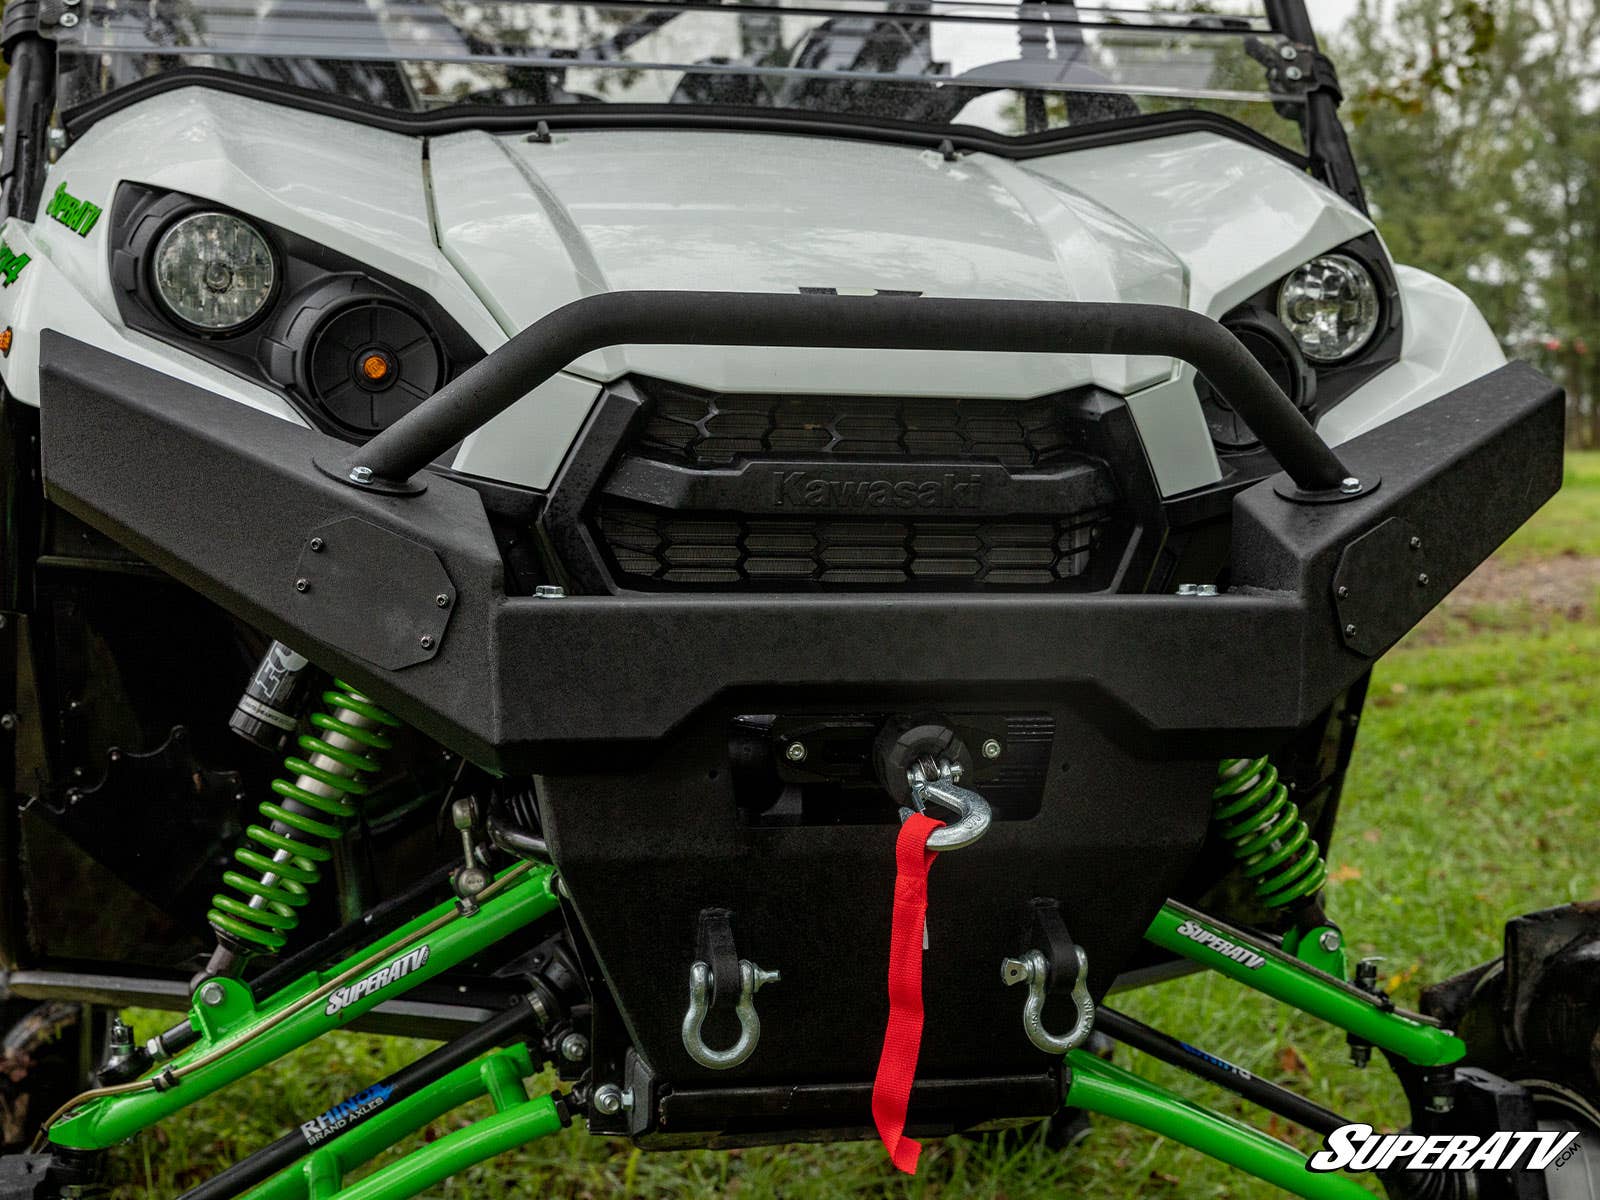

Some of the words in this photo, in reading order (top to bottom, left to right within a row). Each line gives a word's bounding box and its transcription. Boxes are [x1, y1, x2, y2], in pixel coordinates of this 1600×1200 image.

[774, 472, 981, 508] Kawasaki
[1177, 920, 1265, 969] SUPERATV
[325, 944, 429, 1016] SUPERATV
[307, 1119, 347, 1145] BRAND
[349, 1097, 384, 1122] AXLES
